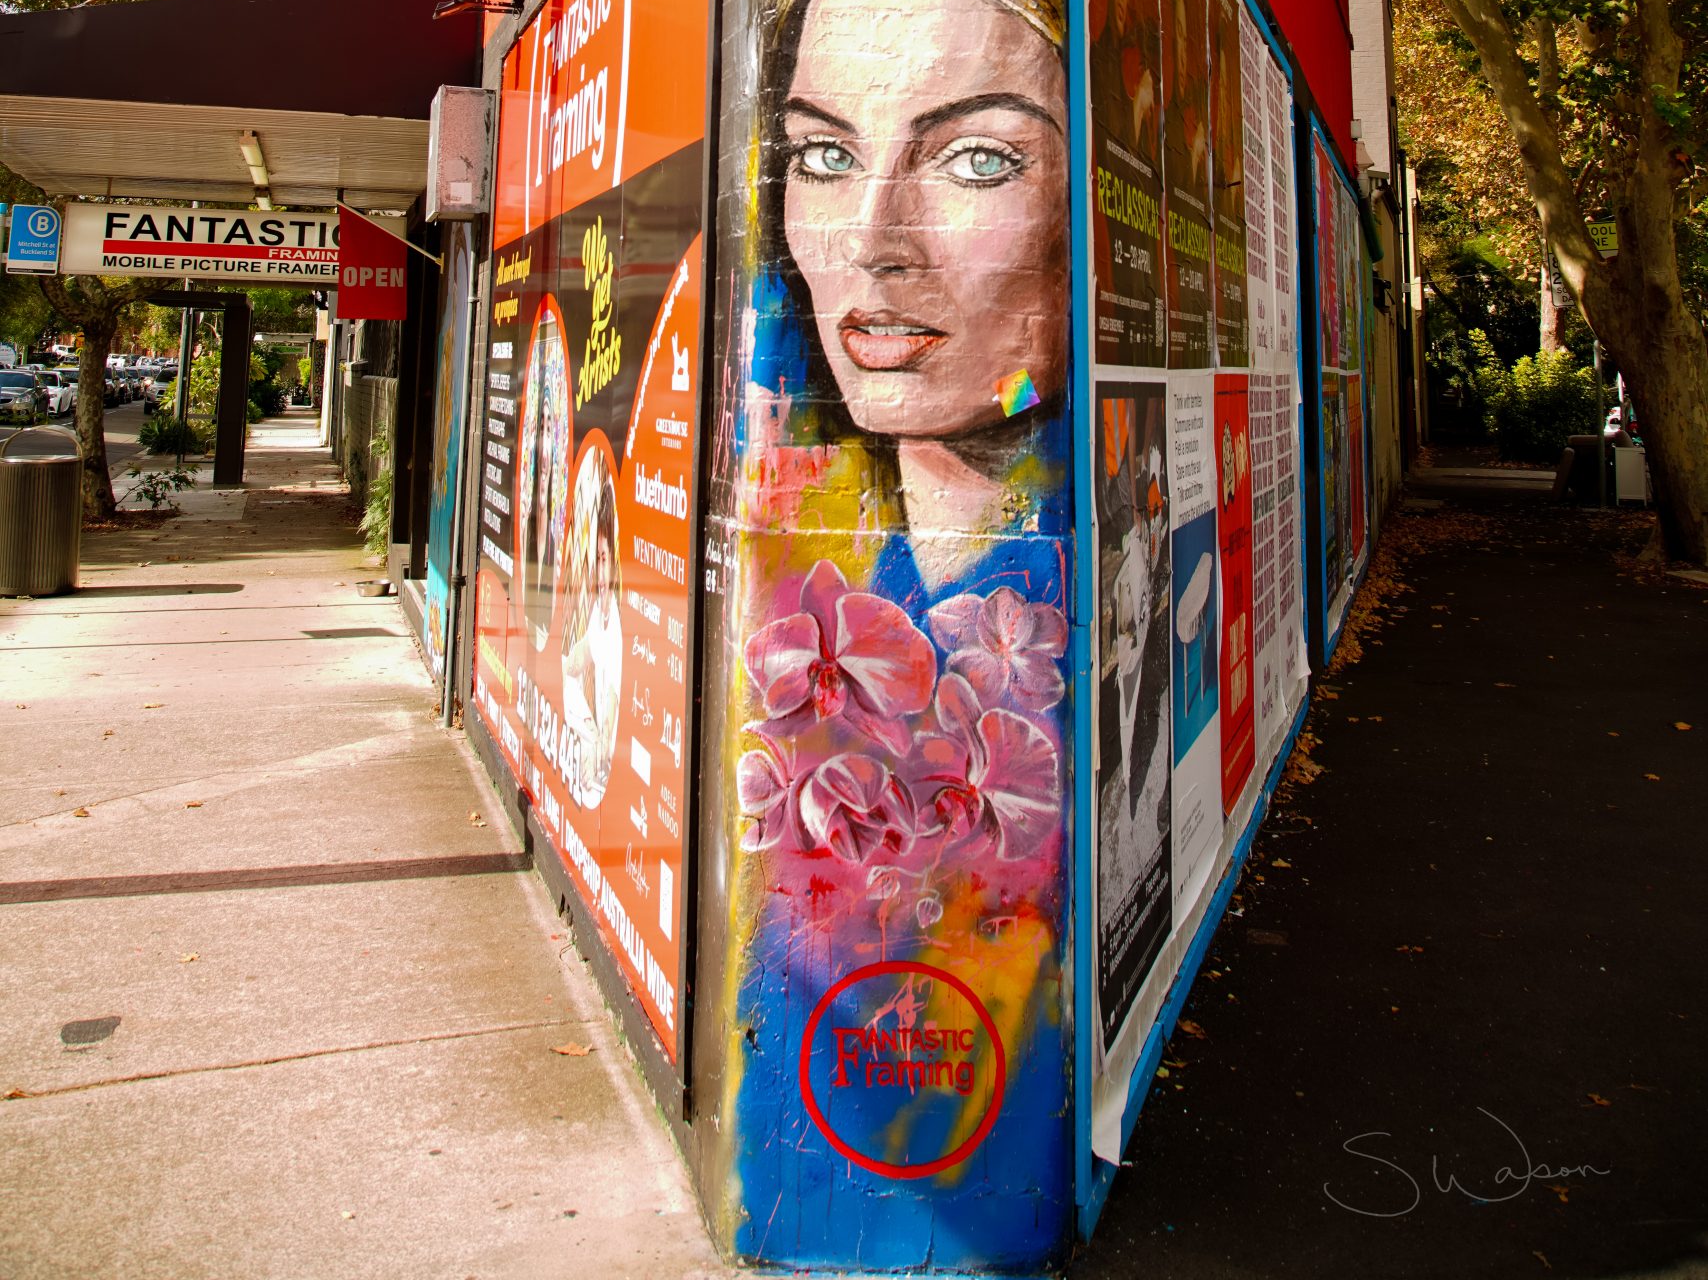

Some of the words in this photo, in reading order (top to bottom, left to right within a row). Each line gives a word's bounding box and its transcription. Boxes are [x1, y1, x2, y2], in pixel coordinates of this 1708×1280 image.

[1098, 166, 1160, 240] RE:CLASSICAL
[18, 241, 41, 249] Mitchell
[102, 255, 174, 270] MOBILE
[181, 258, 261, 273] PICTURE
[268, 248, 338, 261] FRAMIN
[582, 215, 607, 290] We
[343, 266, 404, 287] OPEN
[591, 252, 613, 350] get
[576, 327, 621, 412] Artists
[635, 462, 687, 520] bluethumb
[634, 535, 685, 585] WENTWORTH
[517, 666, 539, 740] 1300
[540, 693, 558, 770] 324
[559, 722, 582, 808] 441
[661, 783, 677, 814] ADELE
[565, 818, 601, 904] DROPSHIP
[601, 876, 646, 983] AUSTRALIA
[645, 954, 674, 1031] WIDE
[832, 1026, 974, 1060] FANTASTIC
